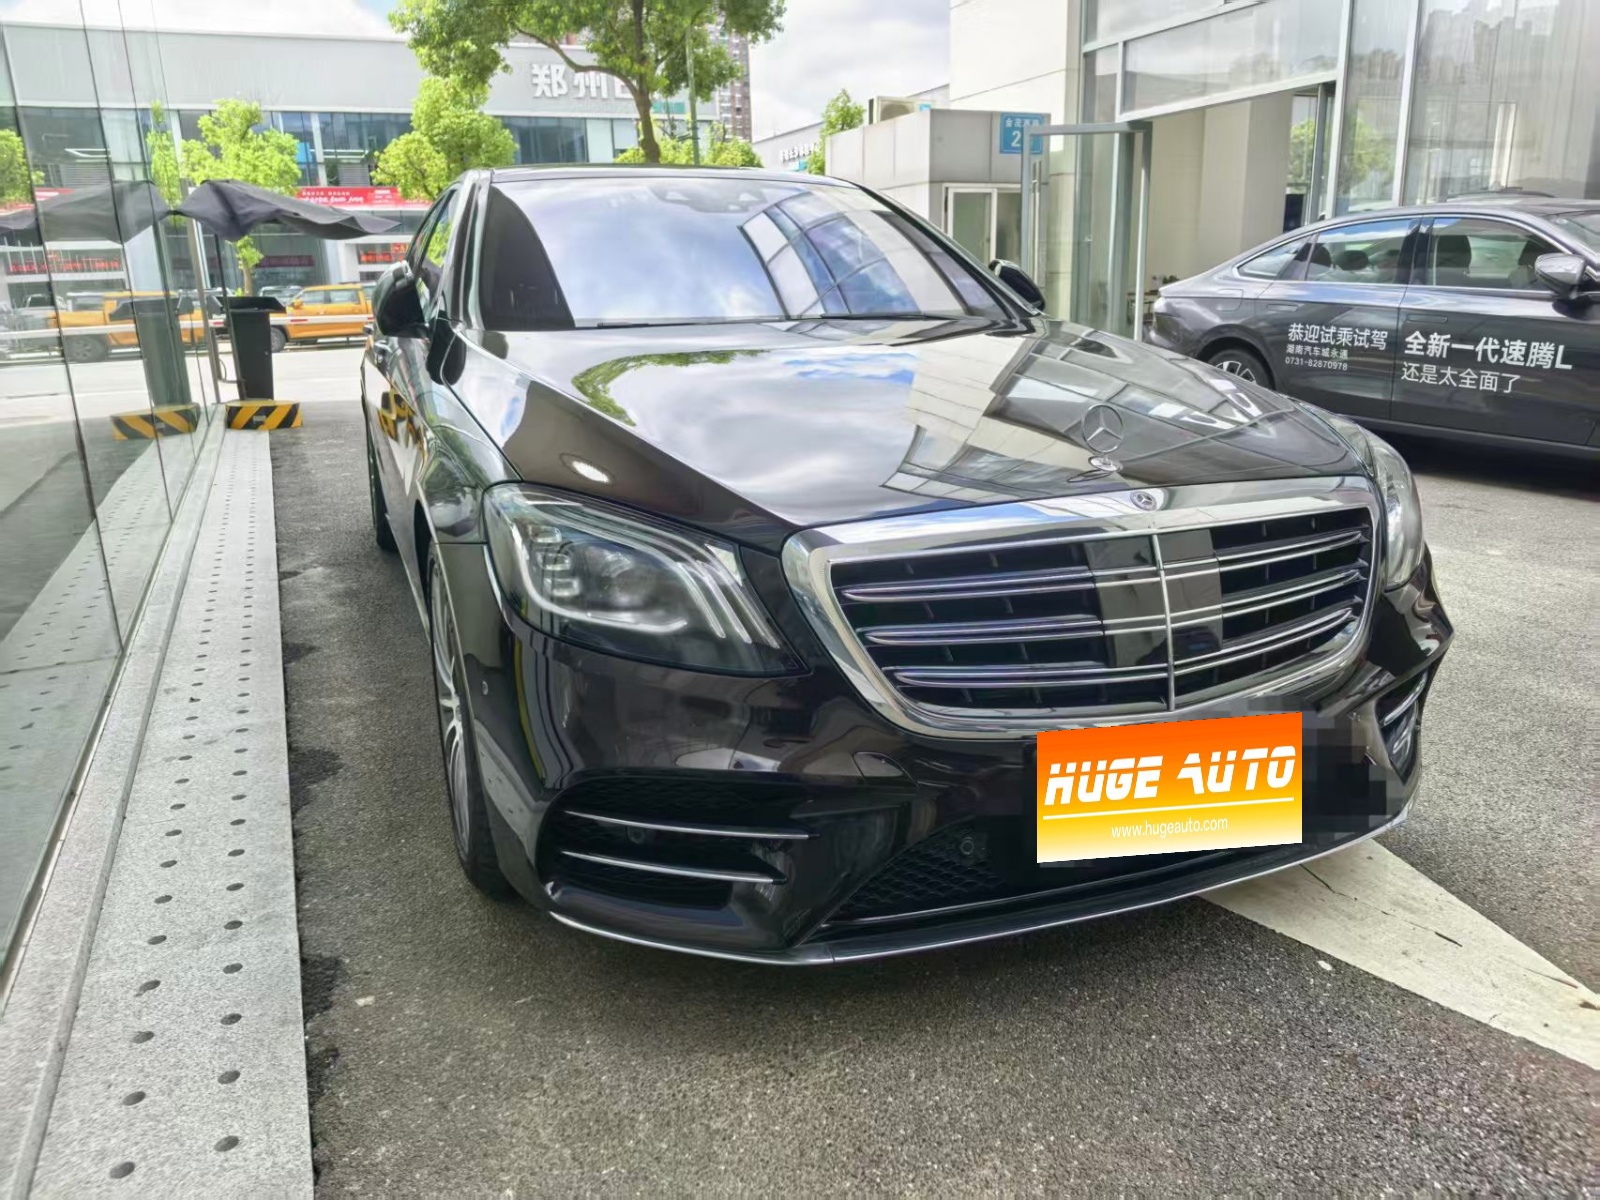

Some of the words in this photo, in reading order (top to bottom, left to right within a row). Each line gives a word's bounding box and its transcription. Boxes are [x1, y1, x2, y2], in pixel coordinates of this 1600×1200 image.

[1287, 322, 1389, 350] 恭迎试乘试驾
[1404, 330, 1573, 370] 全新一代速腾L
[1285, 356, 1348, 371] 0731-82870978
[1286, 343, 1349, 360] 湖南汽车城永通
[1401, 361, 1521, 394] 还是太全面了
